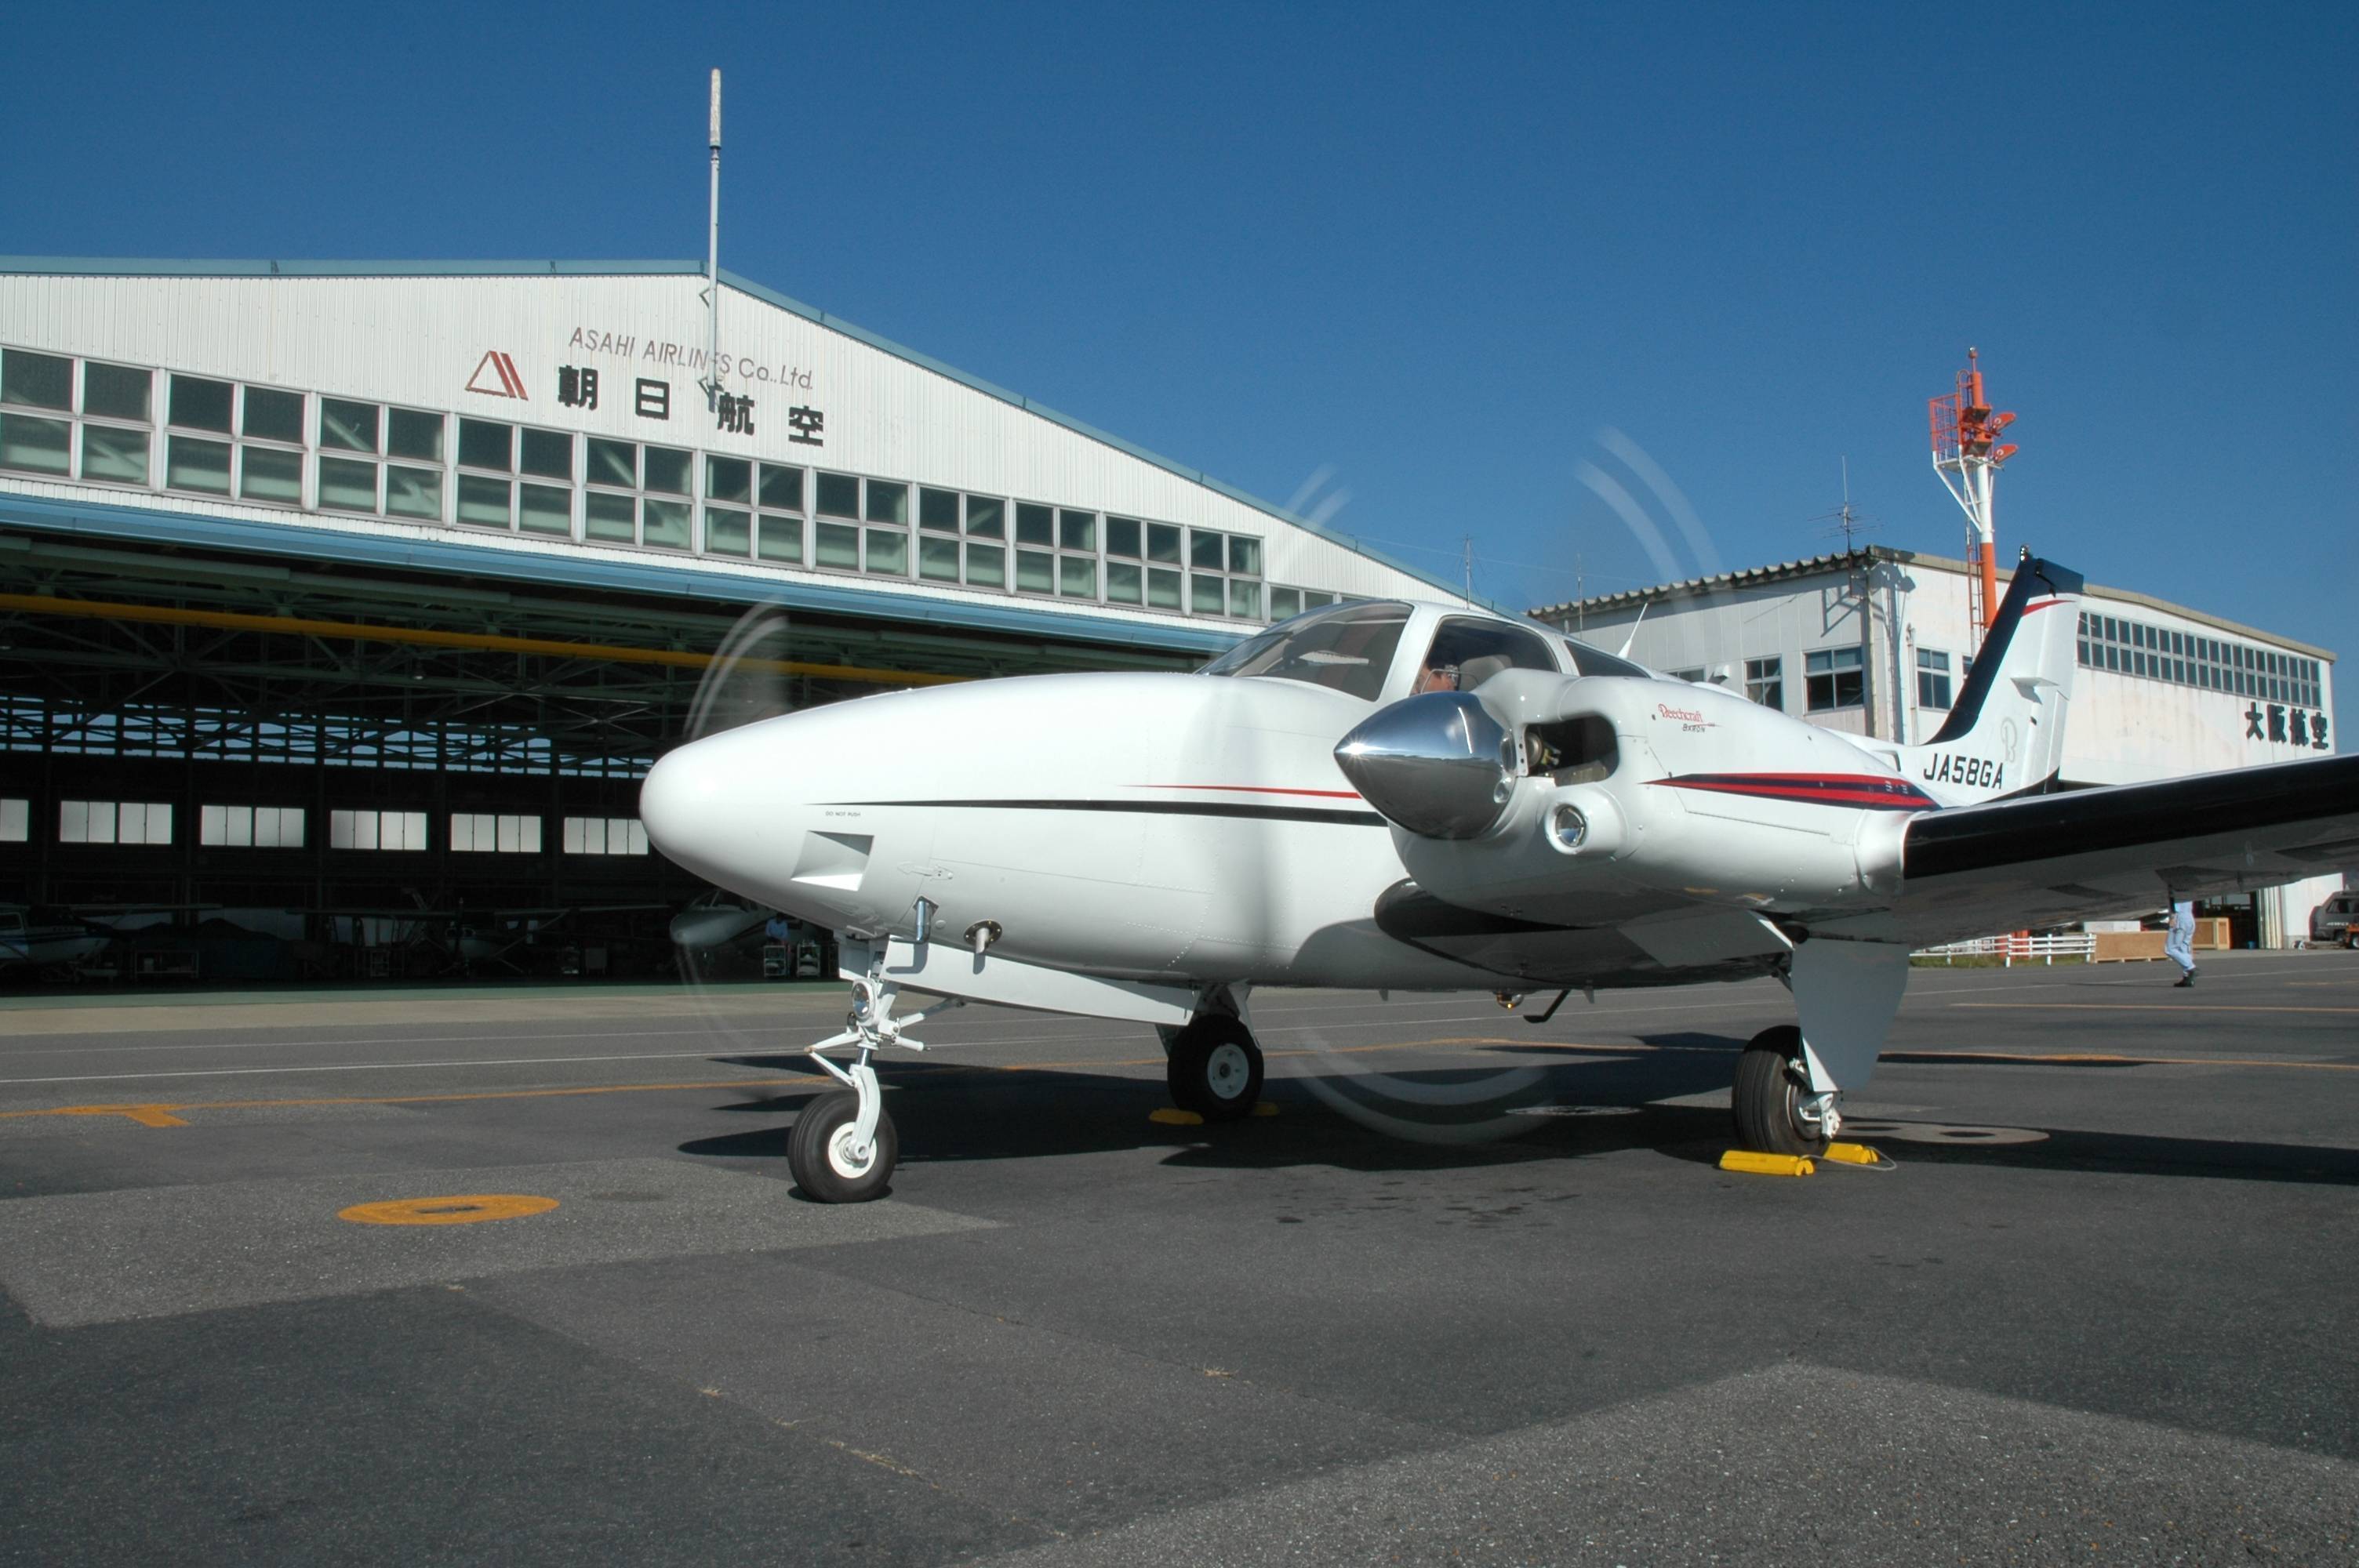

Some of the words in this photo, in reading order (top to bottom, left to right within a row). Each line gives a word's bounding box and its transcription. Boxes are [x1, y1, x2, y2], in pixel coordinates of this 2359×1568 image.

[569, 327, 635, 358] ASAHI
[559, 365, 823, 447] 朝日航空
[1658, 703, 1703, 723] Beechcraft
[1923, 753, 2004, 789] JA58GA
